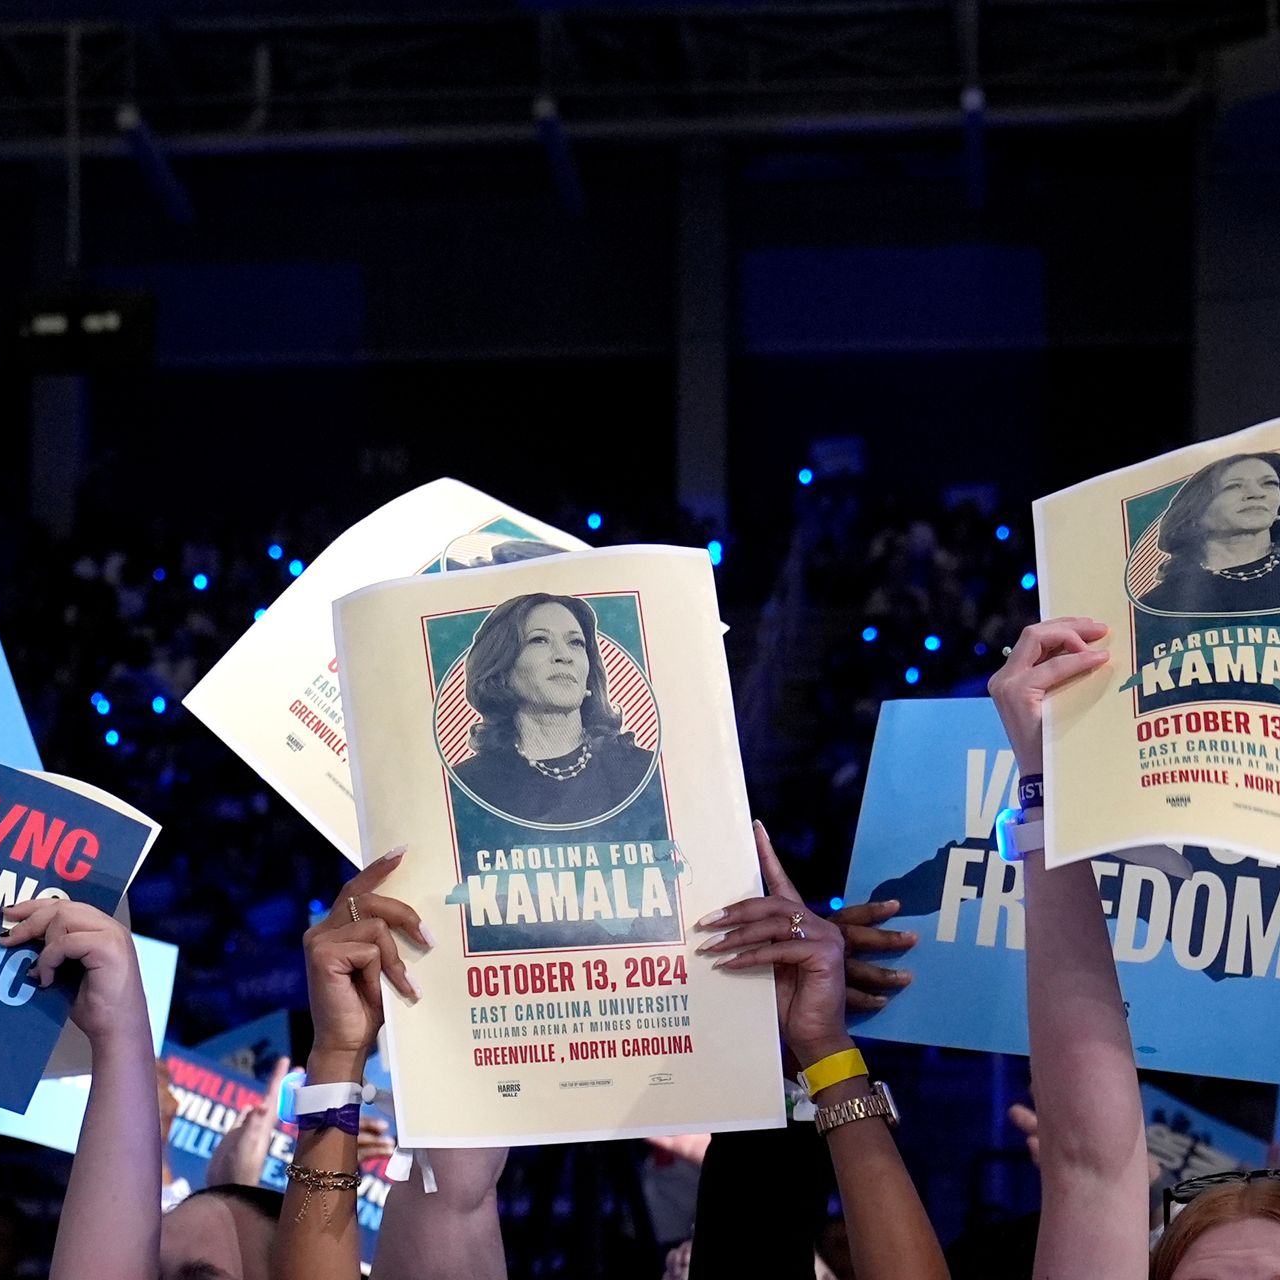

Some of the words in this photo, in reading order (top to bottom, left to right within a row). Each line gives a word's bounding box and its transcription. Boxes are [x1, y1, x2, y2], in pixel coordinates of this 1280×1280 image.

[1153, 627, 1280, 659] CAROLINA
[1137, 710, 1251, 742] OCTOBER
[1139, 741, 1179, 760] EAST
[1186, 739, 1268, 758] CAROLINA
[477, 845, 599, 871] CAROLINA
[610, 843, 654, 865] FOR
[467, 868, 672, 926] KAMALA
[467, 961, 575, 997] OCTOBER
[583, 959, 617, 992] 13,
[624, 955, 688, 988] 2024
[471, 1006, 507, 1024] EAST
[515, 1001, 591, 1021] CAROLINA
[599, 994, 689, 1016] UNIVERSITY
[472, 1026, 528, 1039] WILLIAMS
[533, 1023, 567, 1036] ARENA
[573, 1022, 584, 1033] AT
[590, 1019, 631, 1032] MINGES
[636, 1016, 690, 1030] COLISEUM
[570, 1040, 617, 1060] NORTH
[622, 1035, 693, 1057] CAROLINA
[497, 1084, 521, 1093] HARRIS
